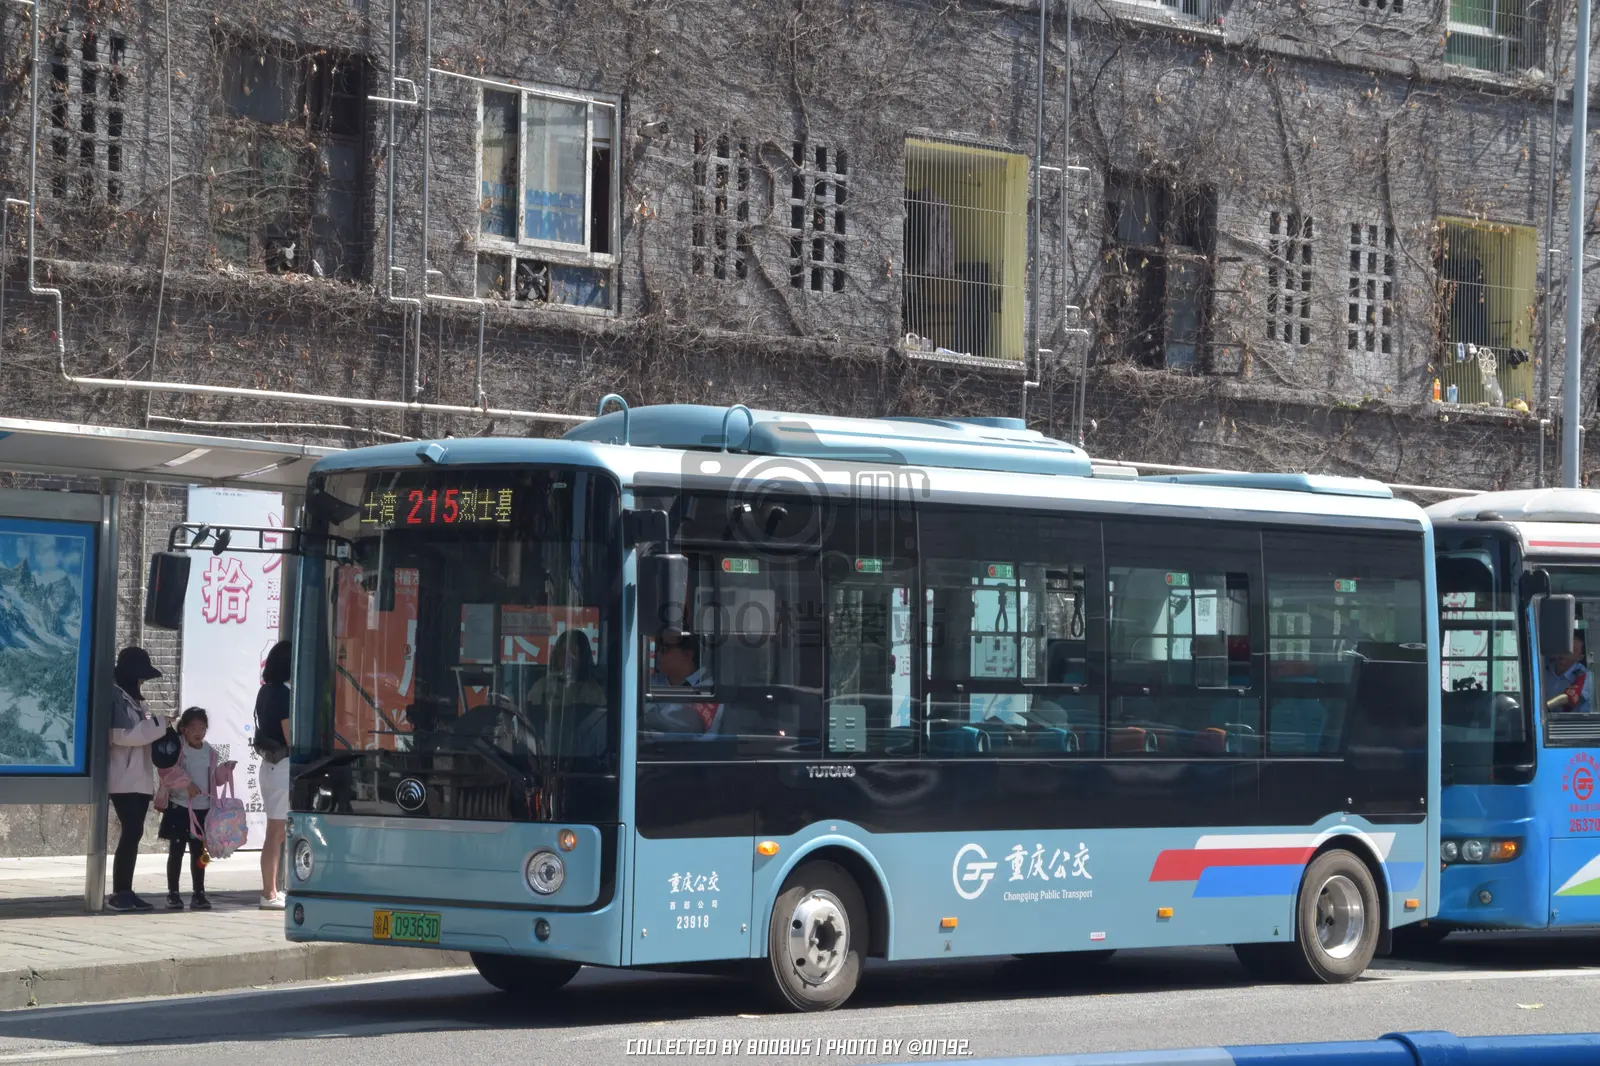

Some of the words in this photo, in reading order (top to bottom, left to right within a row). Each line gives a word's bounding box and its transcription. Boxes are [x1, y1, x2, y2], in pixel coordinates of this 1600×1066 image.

[361, 490, 397, 523] 土湾
[407, 489, 459, 524] 215
[458, 488, 513, 523] 烈士墓
[202, 556, 253, 624] 拾
[1004, 842, 1093, 882] 重庆公交
[667, 871, 720, 894] 重庆公交
[1003, 890, 1039, 903] Chongqing
[1040, 889, 1061, 900] Public
[1061, 889, 1093, 901] Transport
[676, 914, 709, 930] 23918
